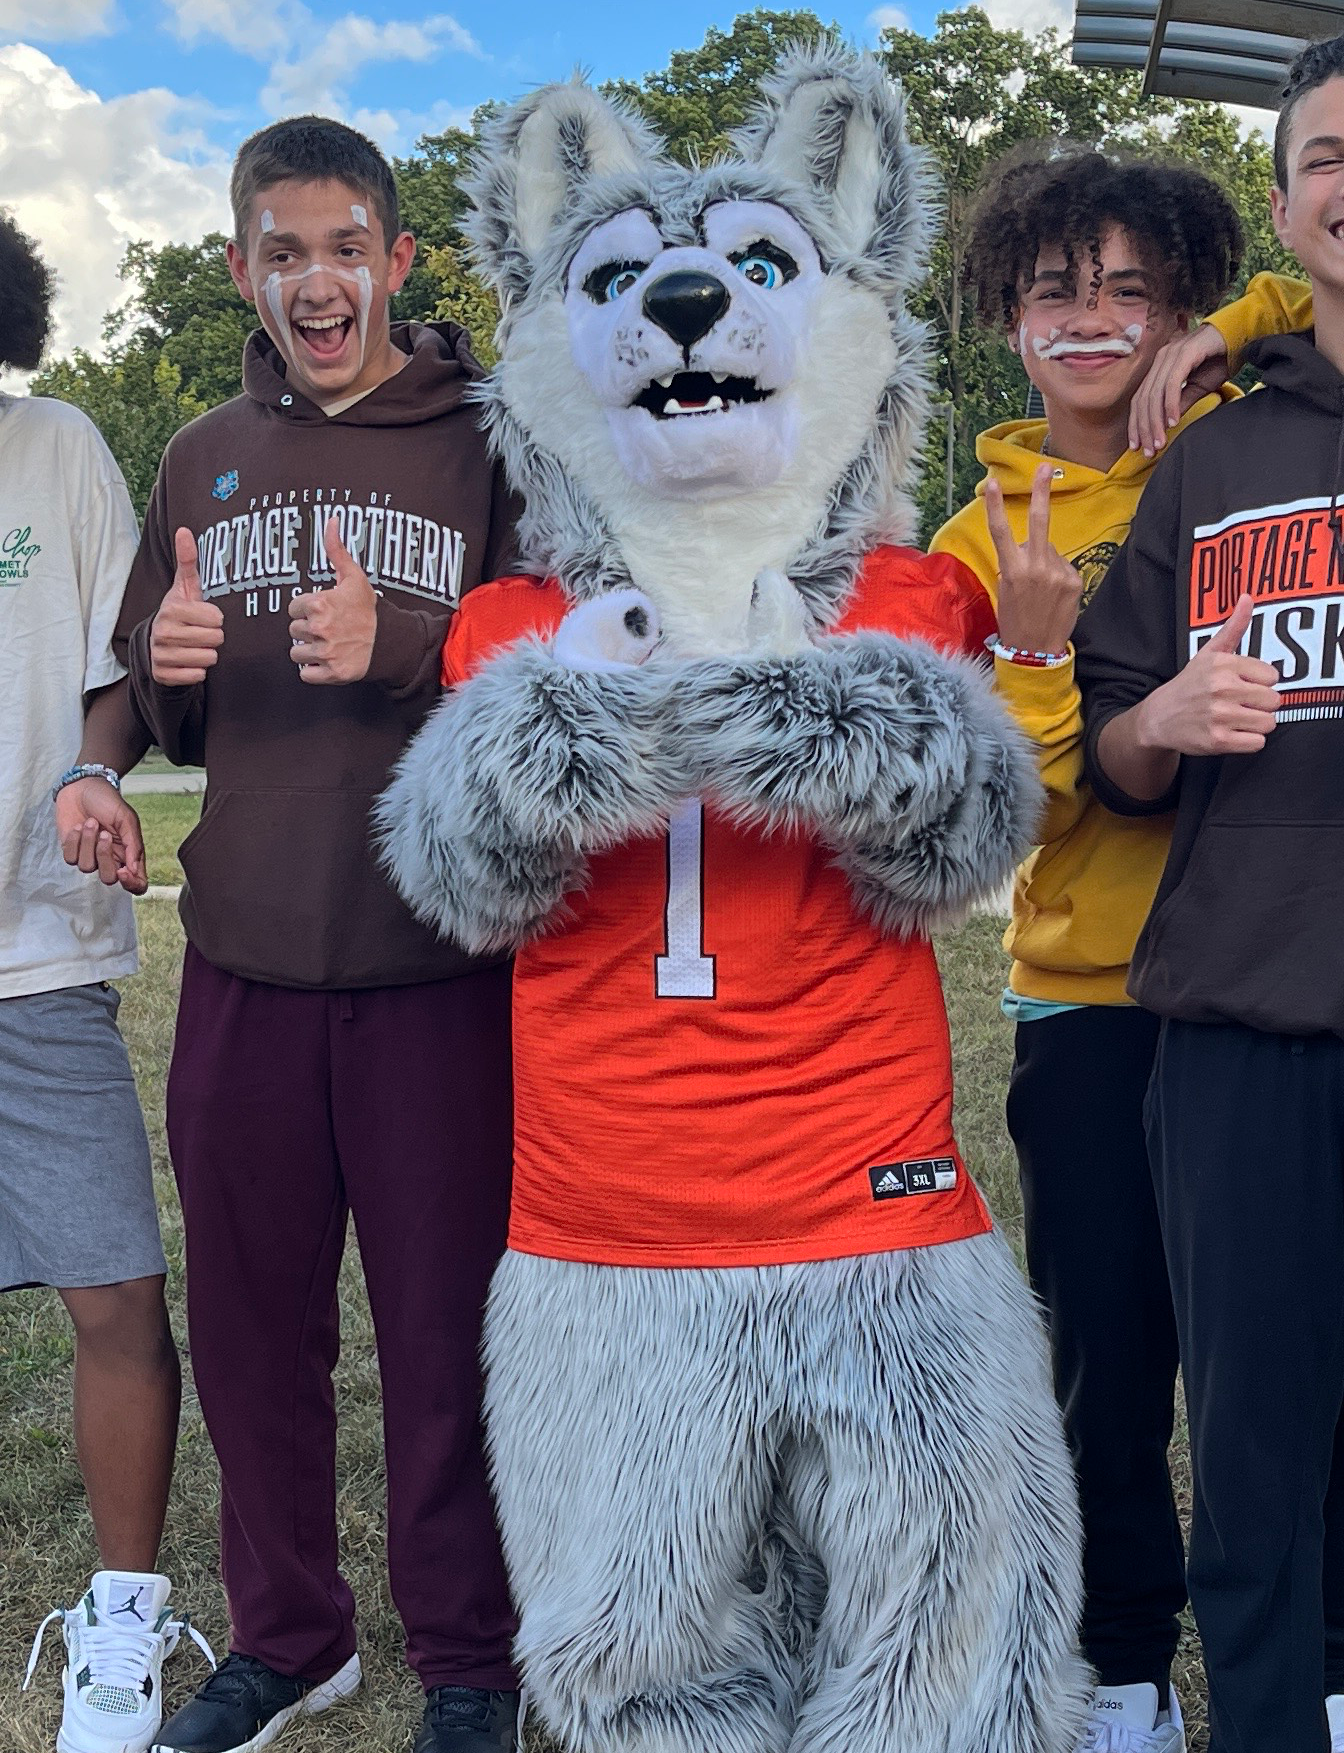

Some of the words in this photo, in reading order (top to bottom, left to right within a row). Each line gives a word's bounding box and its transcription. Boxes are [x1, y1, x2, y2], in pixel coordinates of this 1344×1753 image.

[249, 488, 352, 510] PROPERTY
[370, 491, 392, 506] OF
[311, 504, 465, 602] NORTHERN
[1197, 517, 1323, 619] PORTAGE
[875, 1182, 905, 1194] adidas
[912, 1173, 931, 1187] 3XL
